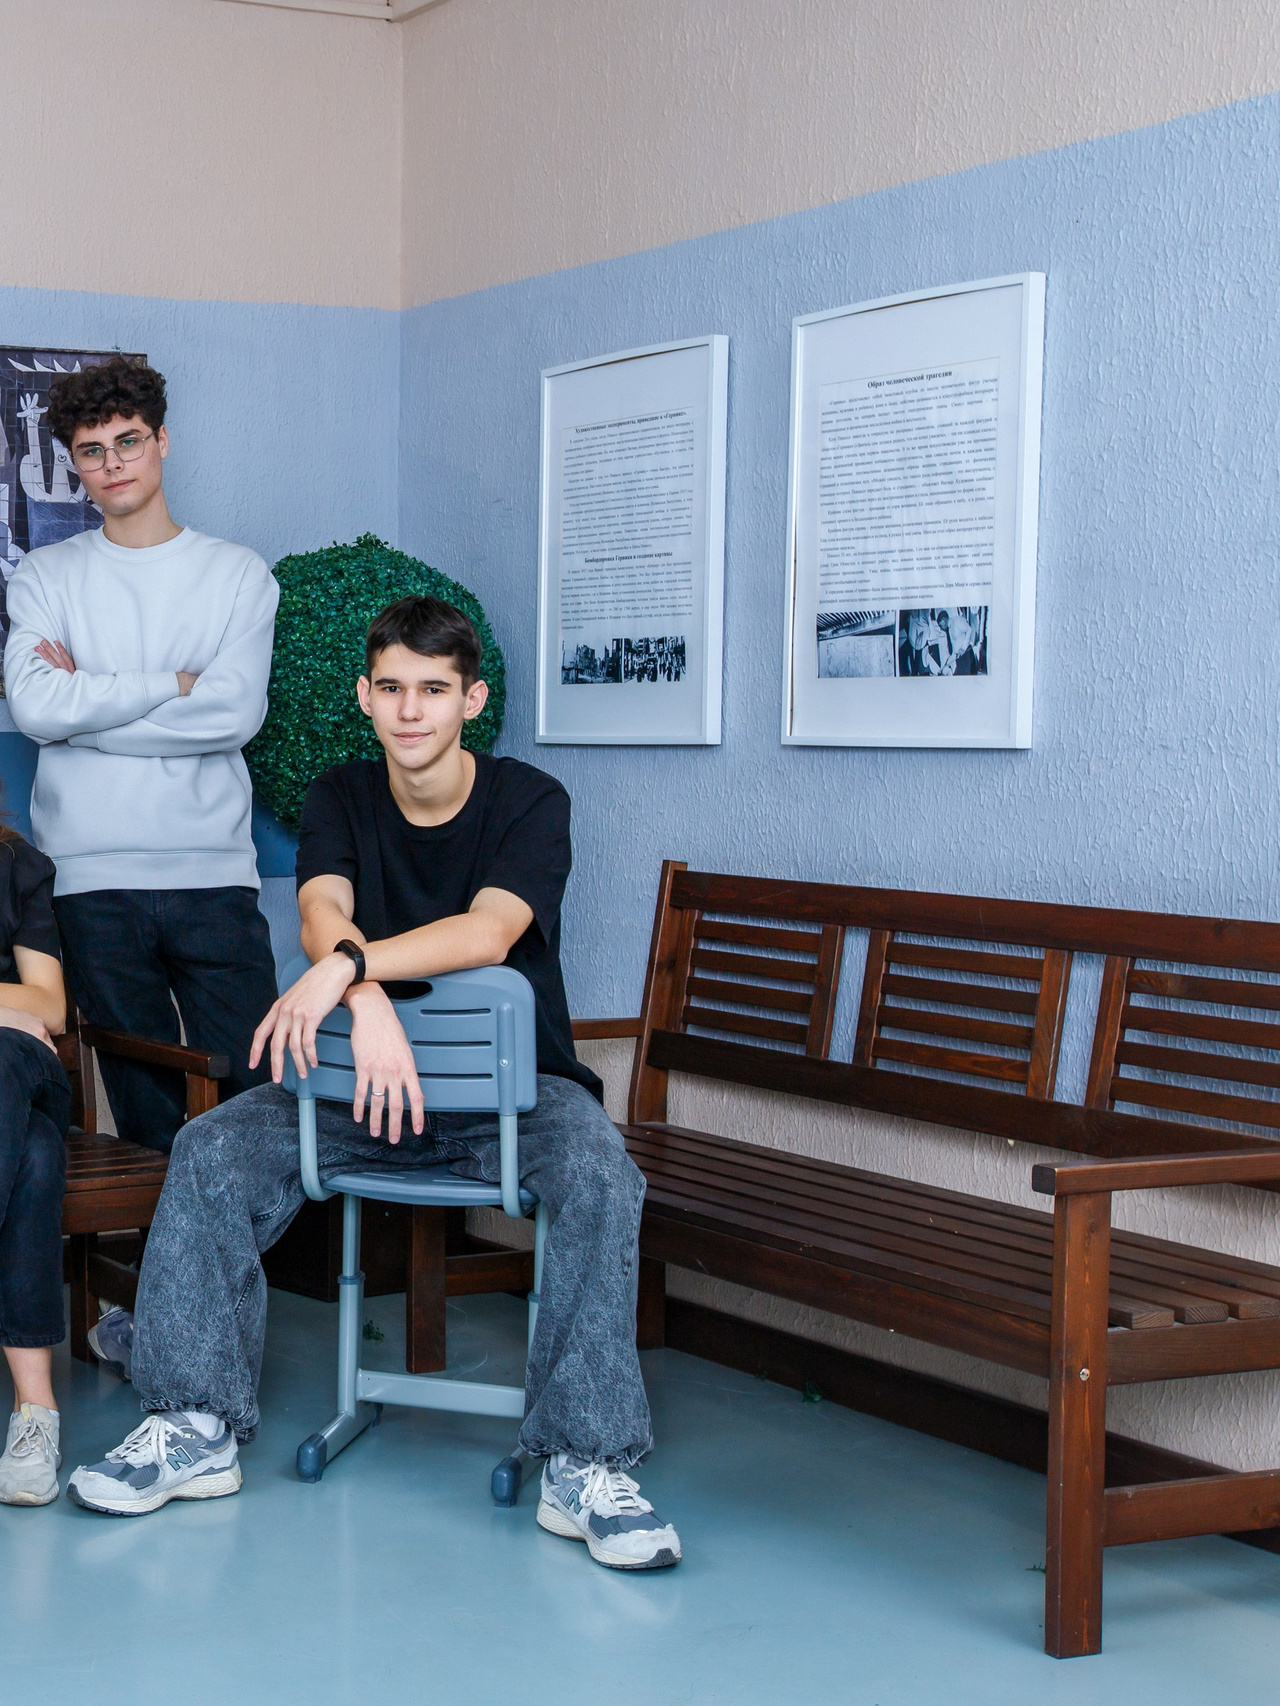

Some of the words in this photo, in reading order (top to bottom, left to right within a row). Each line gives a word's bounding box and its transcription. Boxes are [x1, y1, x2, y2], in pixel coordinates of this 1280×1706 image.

[867, 379, 884, 389] Образ
[885, 373, 924, 385] человеческой
[925, 369, 952, 380] трагедии
